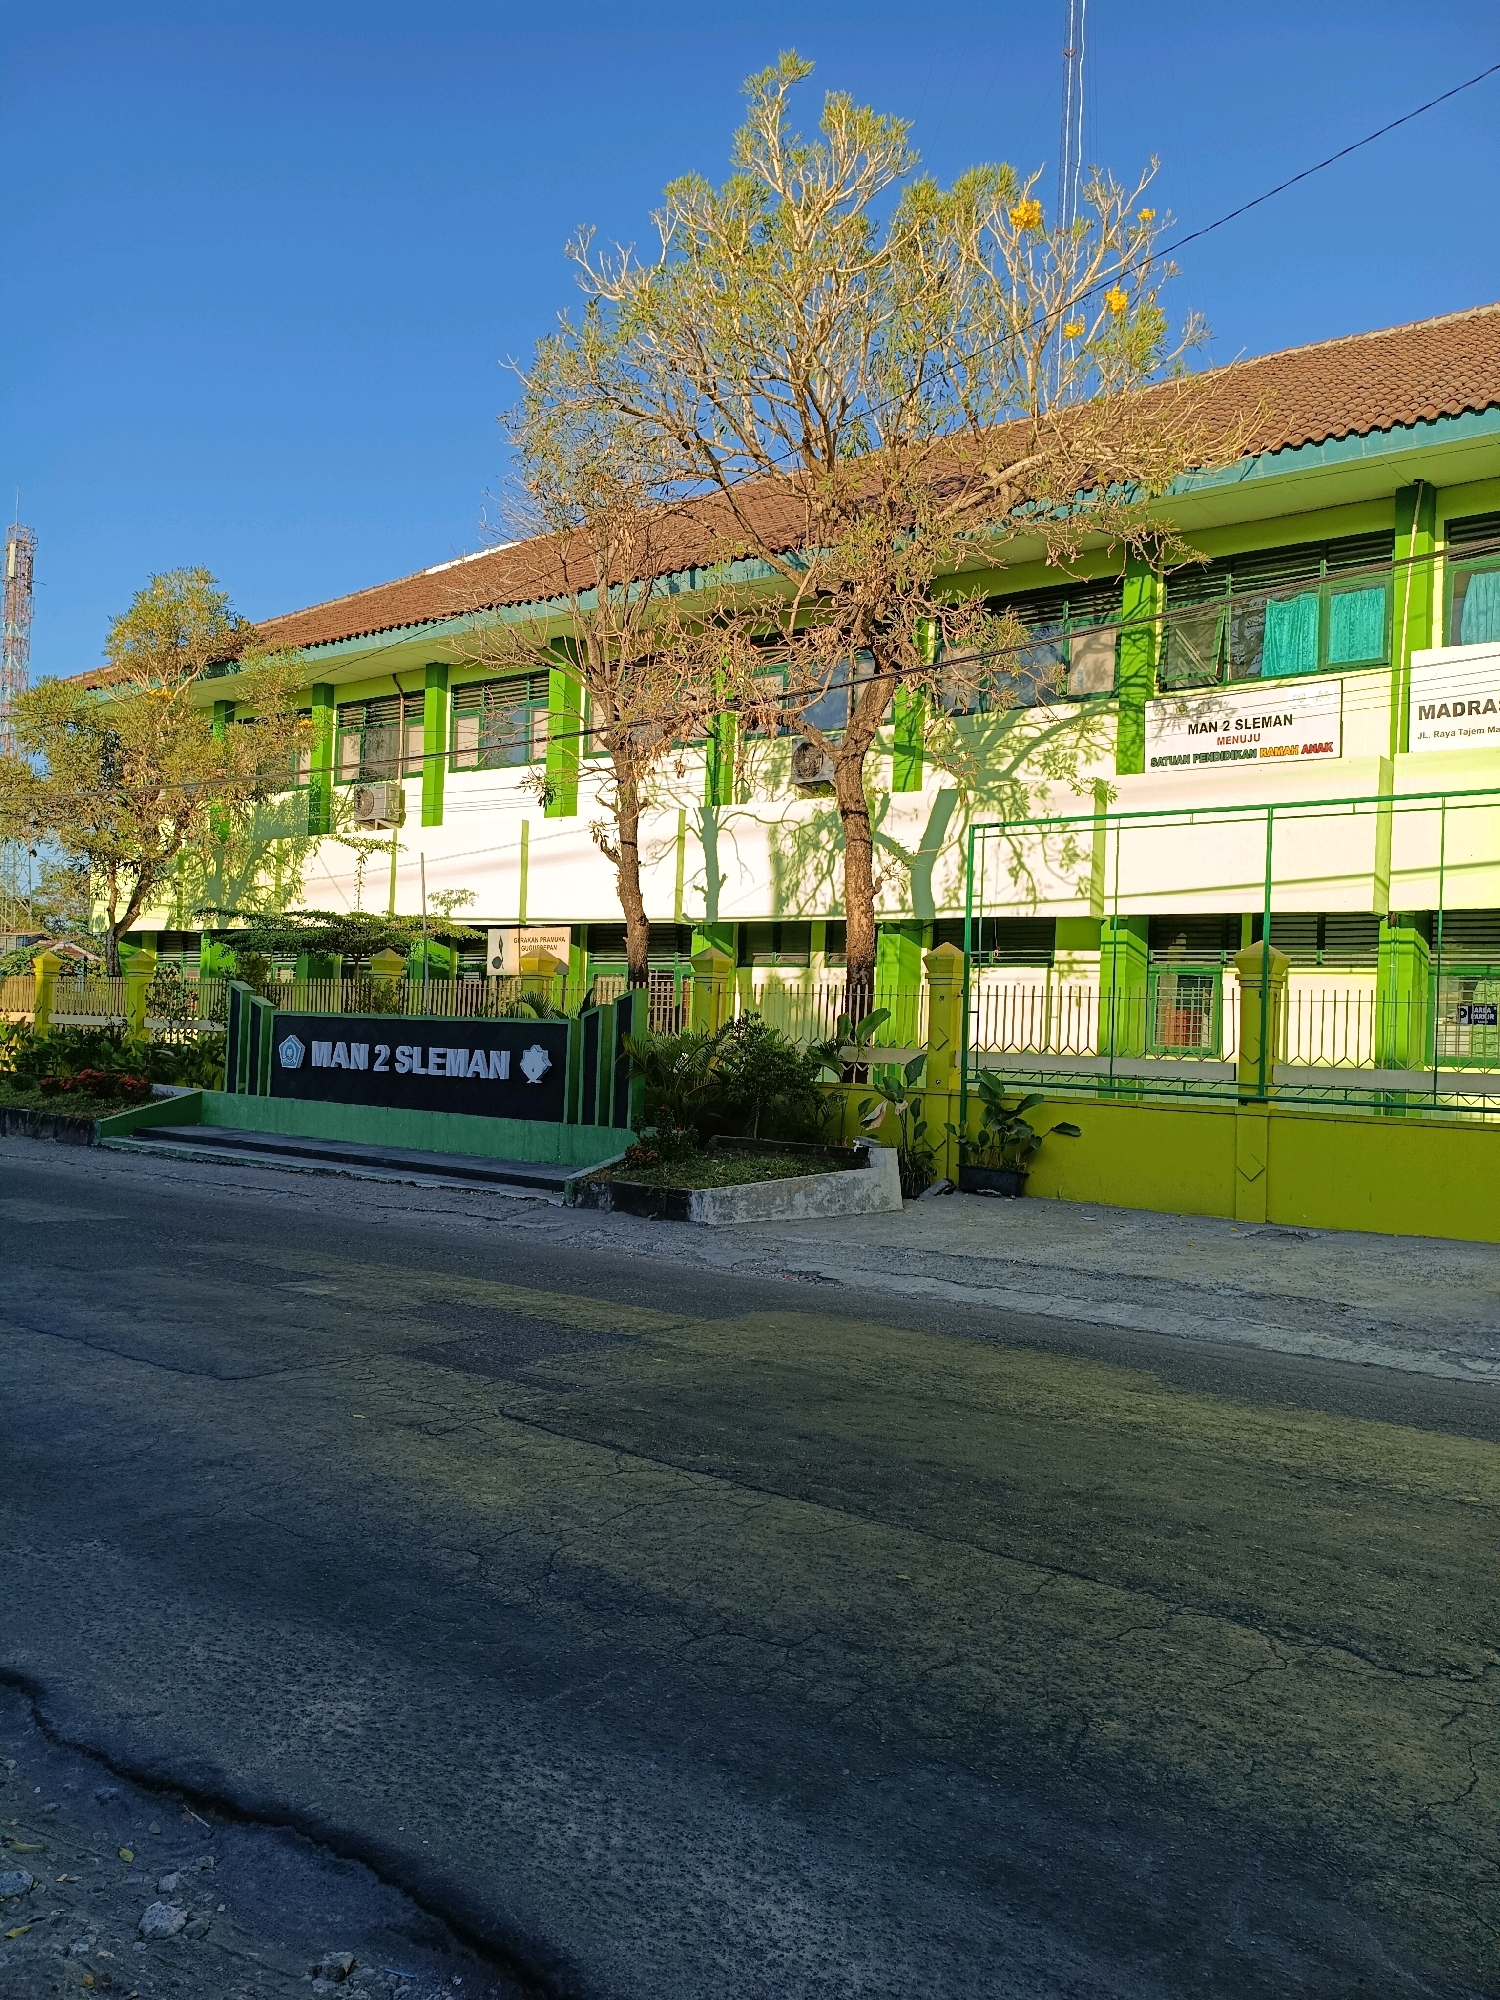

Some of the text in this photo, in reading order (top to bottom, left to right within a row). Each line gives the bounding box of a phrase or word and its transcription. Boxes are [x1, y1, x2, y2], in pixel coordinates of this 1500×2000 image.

[1418, 699, 1500, 720] MADRA
[1188, 714, 1293, 735] MAN 2 SLEMAN
[1433, 730, 1456, 738] Raya
[1458, 728, 1485, 737] Tajem
[1217, 733, 1261, 746] MENUJU
[1150, 742, 1334, 767] SATUAN PENDIDIKAN RAMAH ANAK
[312, 1041, 511, 1080] MAN 2 SLEMAN
